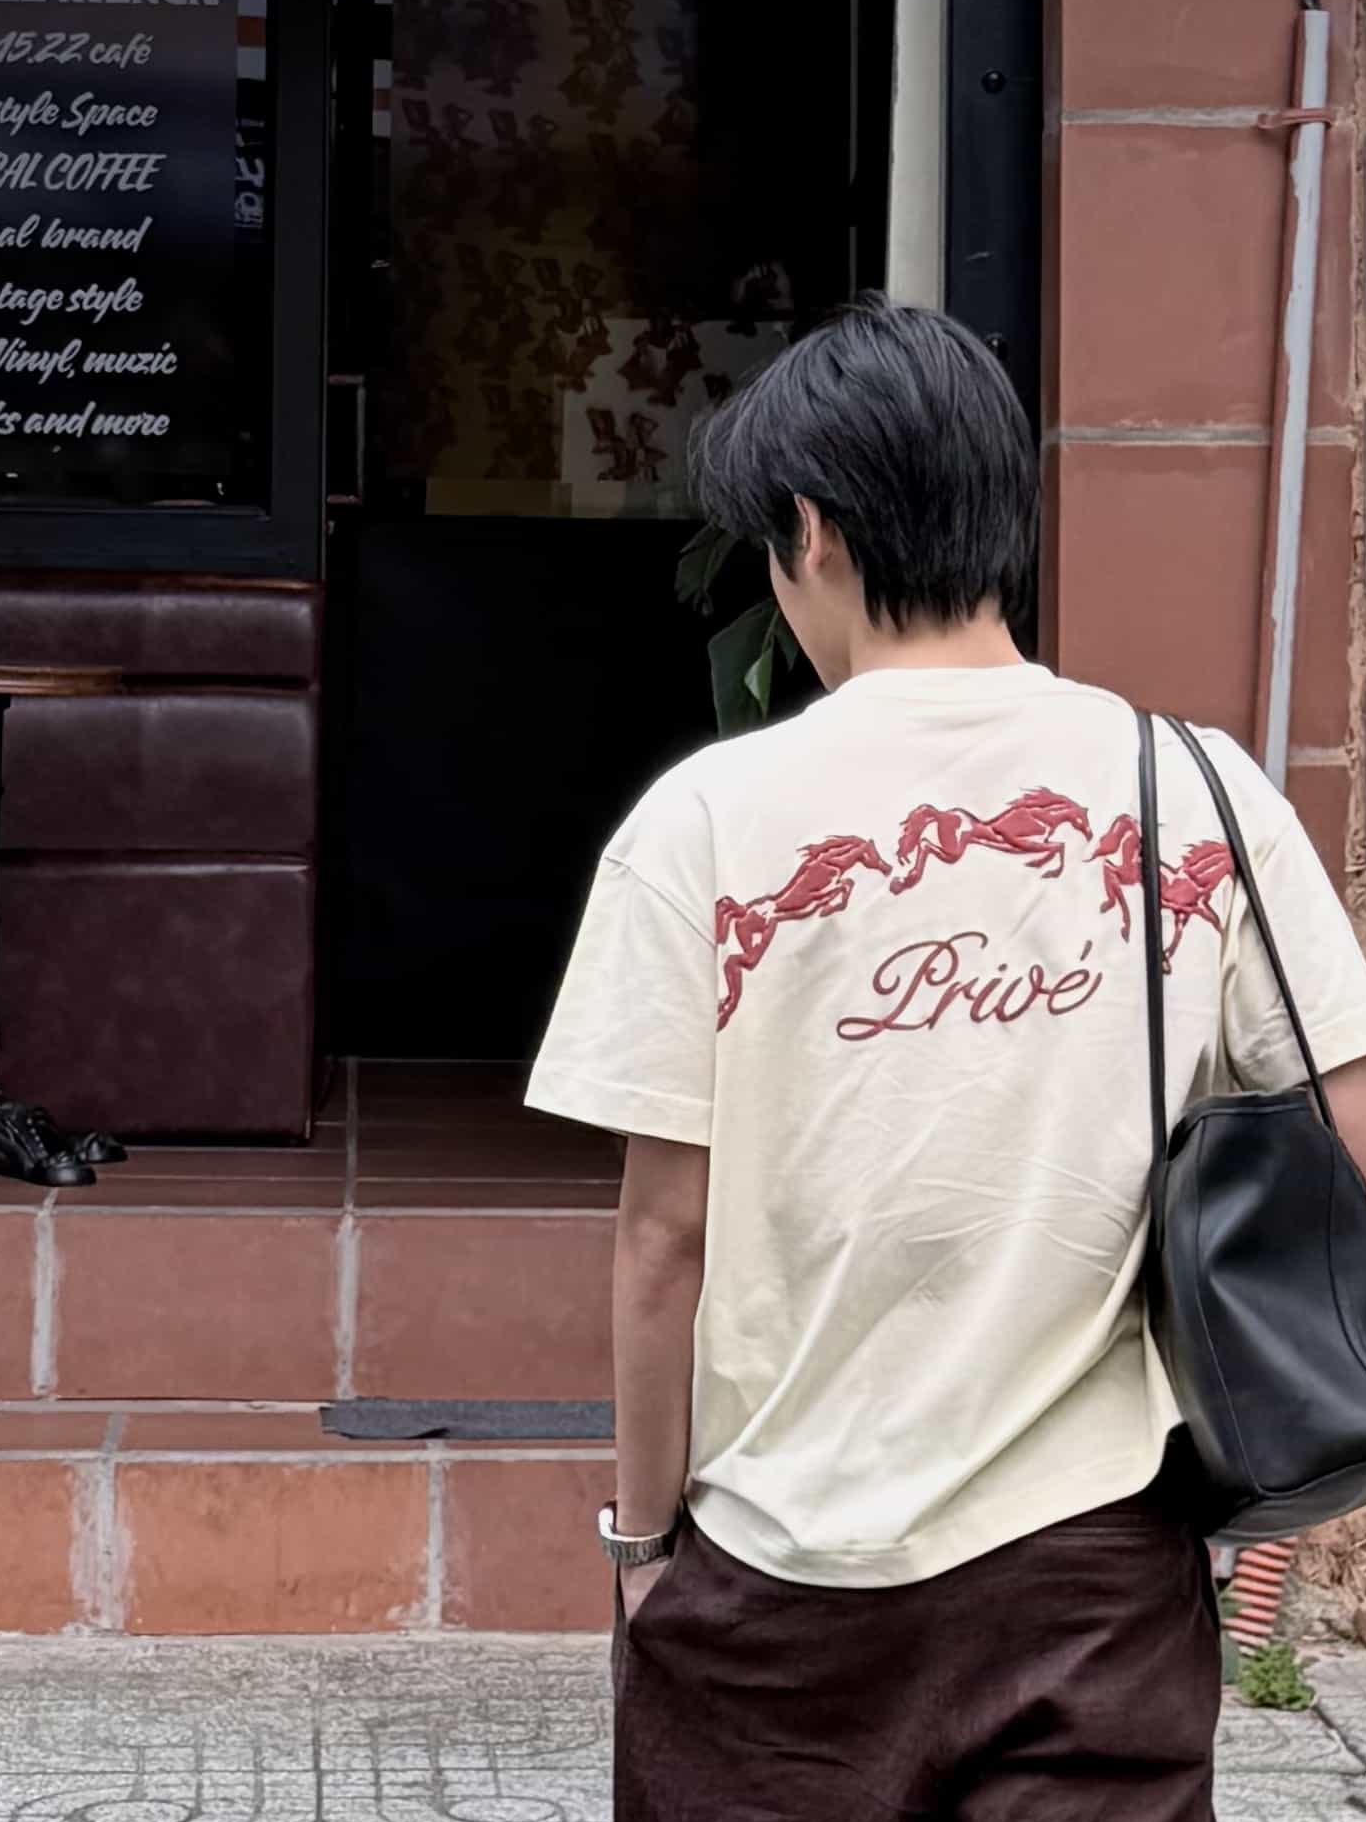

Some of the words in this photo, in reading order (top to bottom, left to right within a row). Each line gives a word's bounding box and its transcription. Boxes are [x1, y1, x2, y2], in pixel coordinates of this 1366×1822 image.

[89, 32, 154, 70] café
[60, 90, 159, 137] Space
[43, 150, 168, 193] COFFEE
[41, 215, 154, 254] brand
[65, 276, 145, 324] style
[82, 340, 179, 375] muzic
[22, 399, 98, 439] and
[90, 410, 171, 436] more
[835, 929, 1103, 1042] Privé
